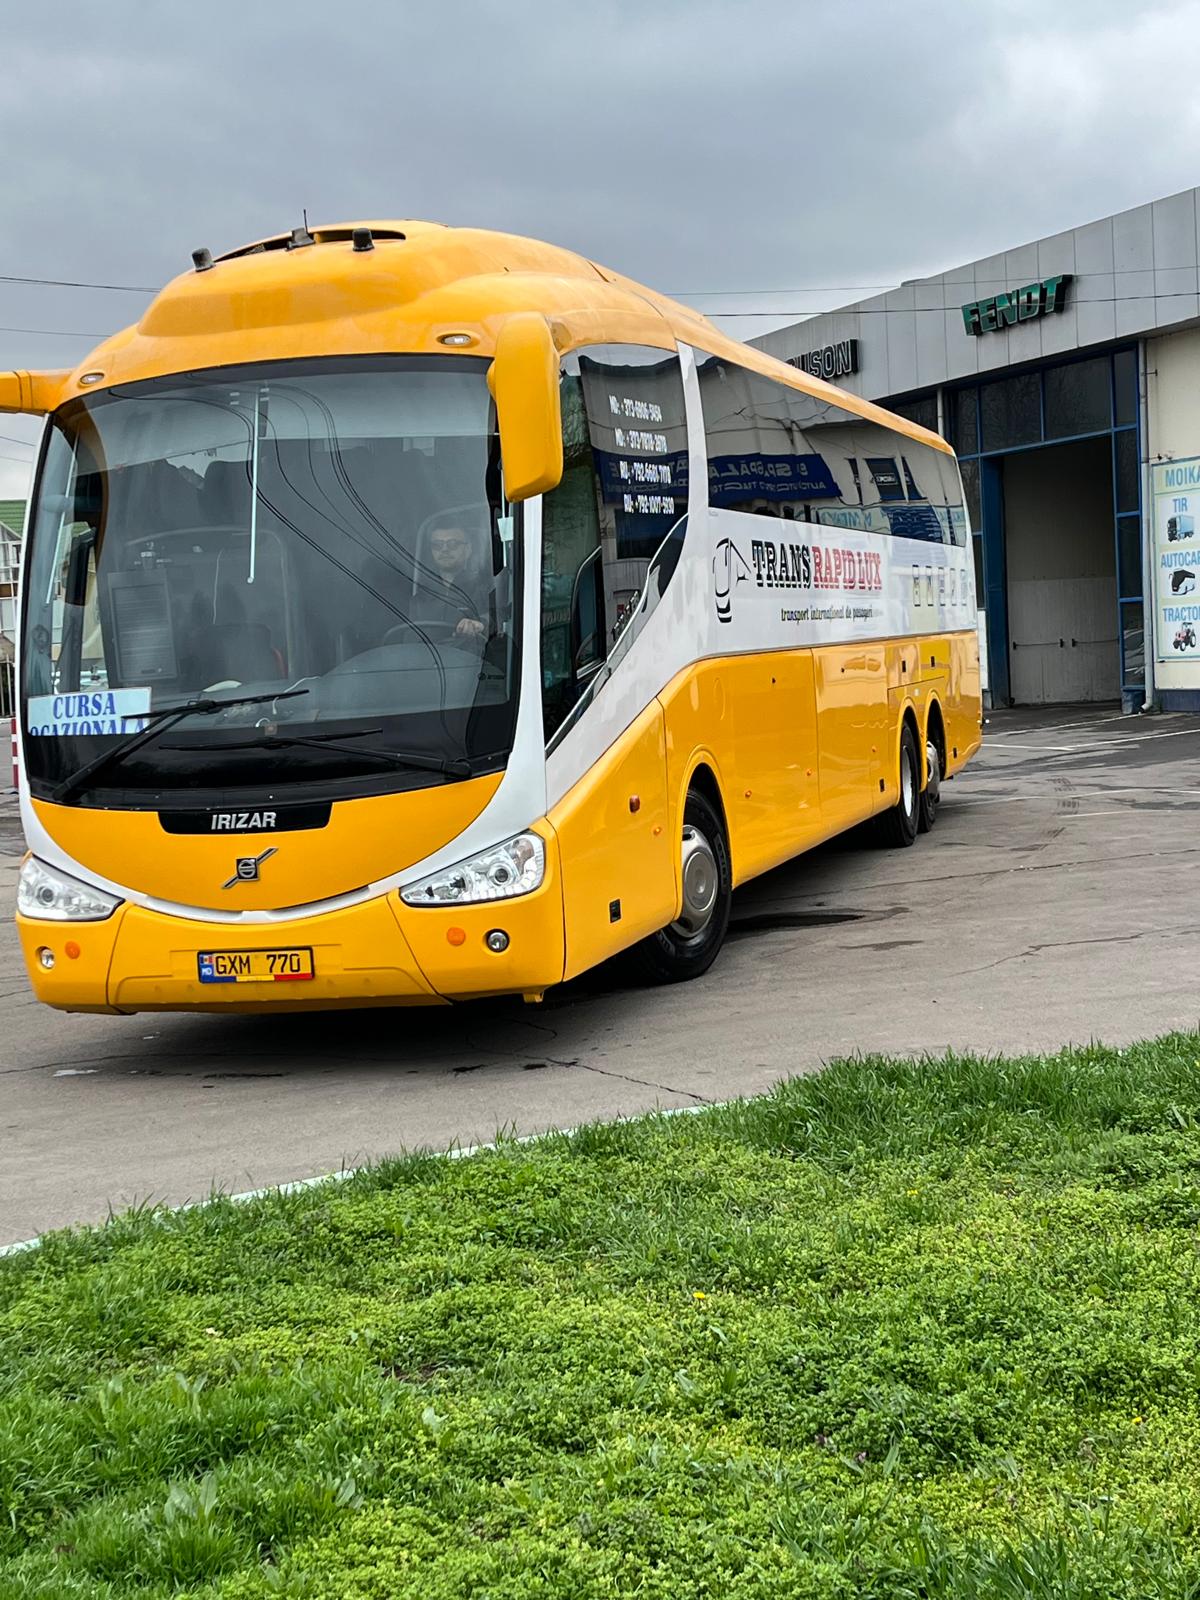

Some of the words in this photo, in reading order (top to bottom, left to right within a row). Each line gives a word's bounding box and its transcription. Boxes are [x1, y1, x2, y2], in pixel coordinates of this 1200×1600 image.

[962, 275, 1068, 336] FENDT
[785, 338, 857, 379] USON
[1173, 497, 1188, 513] TIR
[751, 540, 811, 589] TRANS
[781, 607, 810, 625] transport
[845, 604, 852, 619] de
[1163, 605, 1200, 622] TRACTO
[53, 692, 116, 720] CURSA
[211, 812, 277, 830] IRIZAR
[215, 954, 251, 976] GXM
[266, 953, 301, 974] 770
